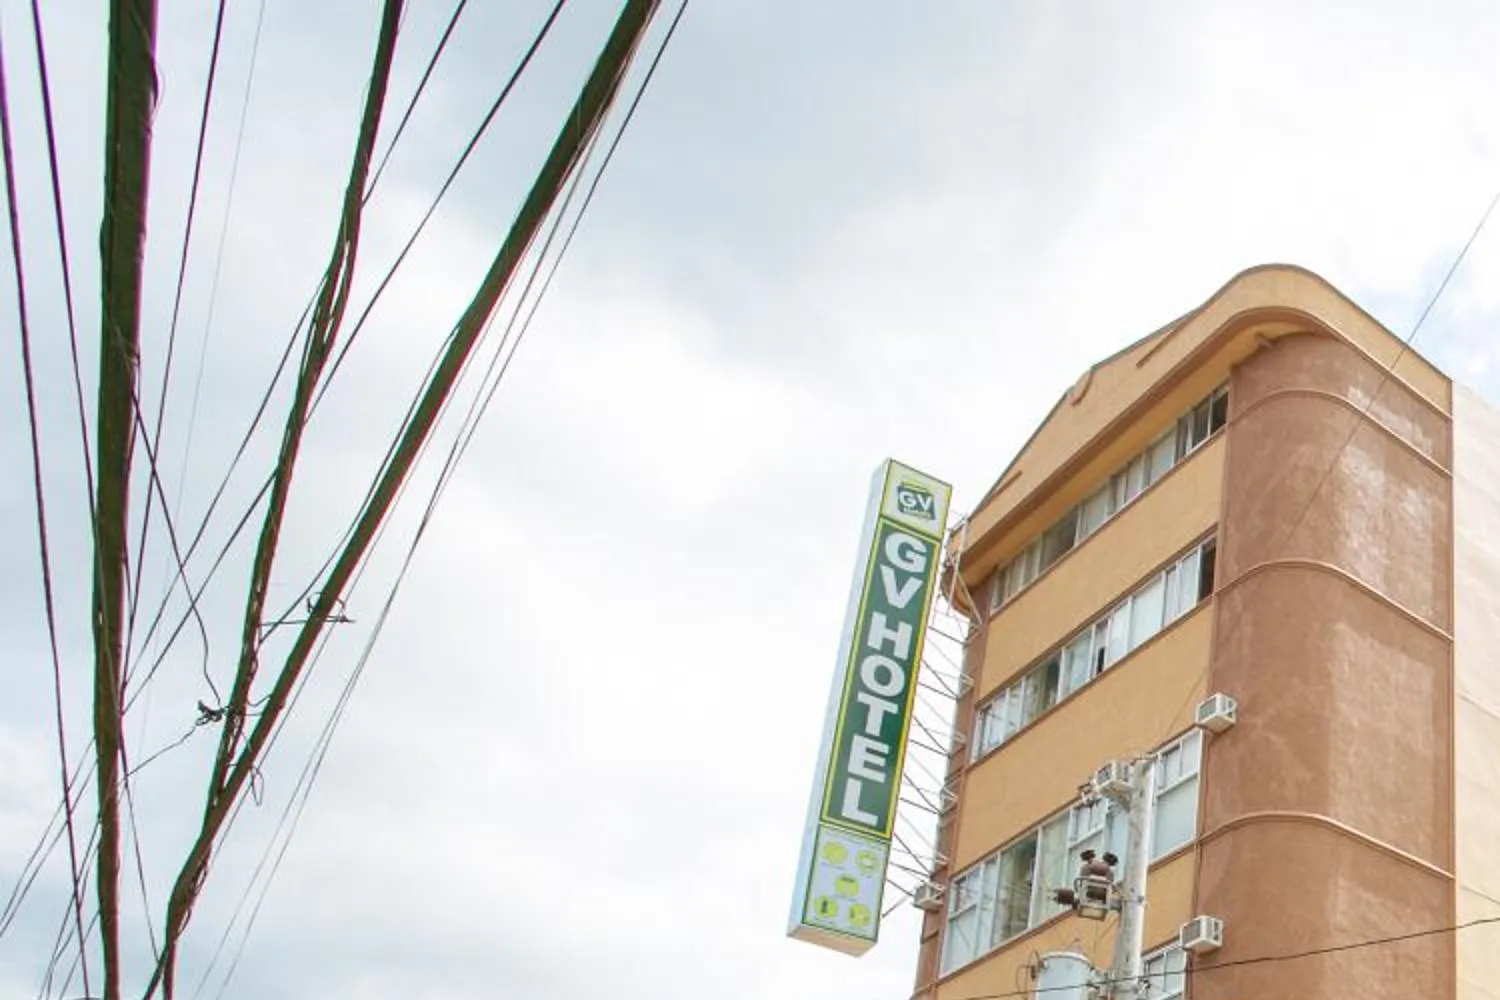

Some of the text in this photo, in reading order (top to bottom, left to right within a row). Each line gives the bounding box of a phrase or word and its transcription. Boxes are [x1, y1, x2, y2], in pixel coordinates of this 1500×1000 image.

[900, 491, 932, 510] GV
[880, 533, 928, 610] GV
[841, 622, 910, 828] HOTEL
